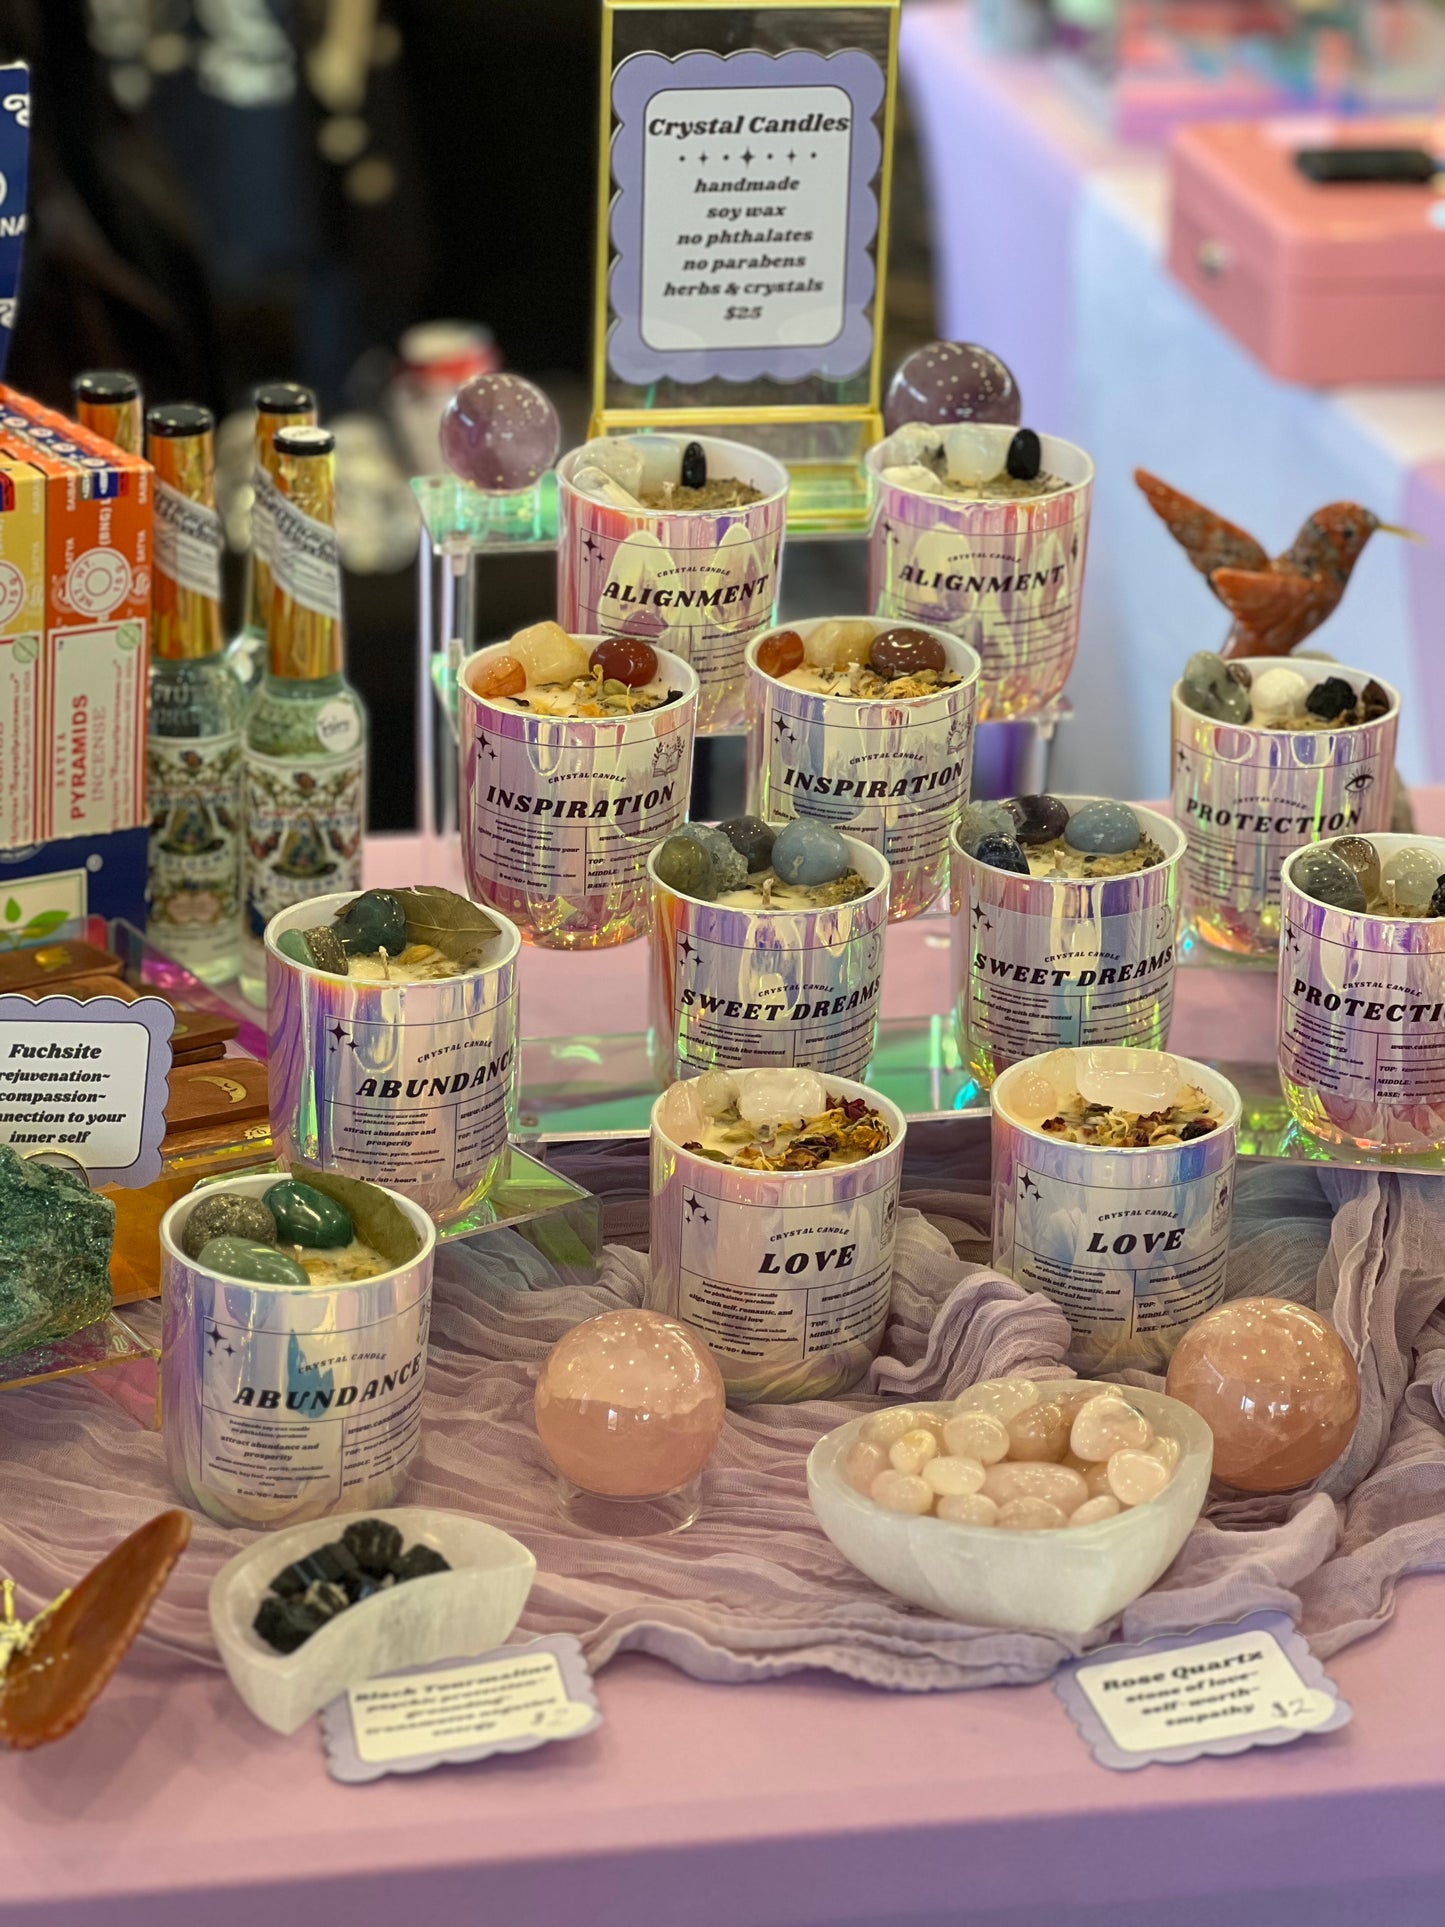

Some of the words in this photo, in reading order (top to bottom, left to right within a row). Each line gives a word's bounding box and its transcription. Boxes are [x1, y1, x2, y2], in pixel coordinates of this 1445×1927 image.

[648, 115, 744, 139] Crystal
[749, 113, 849, 134] Candles
[693, 177, 800, 193] handmade
[706, 205, 742, 221] soy
[746, 205, 786, 218] wax
[677, 233, 702, 246] no
[705, 230, 814, 248] phthalates
[682, 259, 707, 271] no
[711, 255, 807, 274] parabens
[663, 282, 721, 296] herbs
[725, 282, 741, 296] &
[743, 279, 823, 296] crystals
[657, 566, 697, 578] CRYSTAL
[699, 566, 732, 576] CANDLE
[898, 565, 1065, 593] ALIGNMENT
[603, 575, 769, 608] ALIGNMENT
[71, 695, 88, 820] PYRAMIDS
[92, 707, 106, 802] INCENSE
[849, 753, 890, 765] CRYSTAL
[892, 752, 925, 761] CANDLE
[548, 773, 589, 784] CRYSTAL
[592, 772, 626, 782] CANDLE
[783, 758, 965, 798] INSPIRATION
[486, 782, 675, 818] INSPIRATION
[1186, 798, 1362, 835] PROTECTION
[974, 952, 1071, 987] SWEET
[1076, 944, 1174, 987] DREAMS
[1044, 951, 1085, 963] CRYSTAL
[1087, 951, 1120, 961] CANDLE
[680, 988, 786, 1021] SWEET
[790, 974, 881, 1021] DREAMS
[758, 984, 800, 998] CRYSTAL
[802, 983, 835, 993] CANDLE
[1342, 981, 1384, 990] CRYSTAL
[1386, 983, 1423, 997] CANDLE
[1292, 978, 1445, 1023] PROTECTI
[9, 1043, 102, 1059] Fuchsite
[417, 1044, 462, 1064] CRYSTAL
[464, 1040, 493, 1049] CANDLE
[68, 1112, 85, 1123] to
[86, 1113, 126, 1125] your
[9, 1131, 56, 1143] inner
[58, 1131, 91, 1143] self
[344, 1127, 372, 1135] attract
[1098, 1209, 1143, 1222] CRYSTAL
[1144, 1209, 1180, 1219] CANDLE
[769, 1227, 815, 1242] CRYSTAL
[817, 1226, 850, 1236] CANDLE
[1086, 1227, 1186, 1255] LOVE
[758, 1243, 857, 1275] LOVE
[298, 1355, 348, 1375] CRYSTAL
[351, 1353, 387, 1362] CANDLE
[233, 1352, 422, 1412] ABUNDANCE
[250, 1441, 300, 1450] abundance
[244, 1450, 293, 1461] prosperity
[1103, 1672, 1165, 1691] Rose
[1171, 1650, 1264, 1679] Quartz
[1165, 1703, 1255, 1726] empathy
